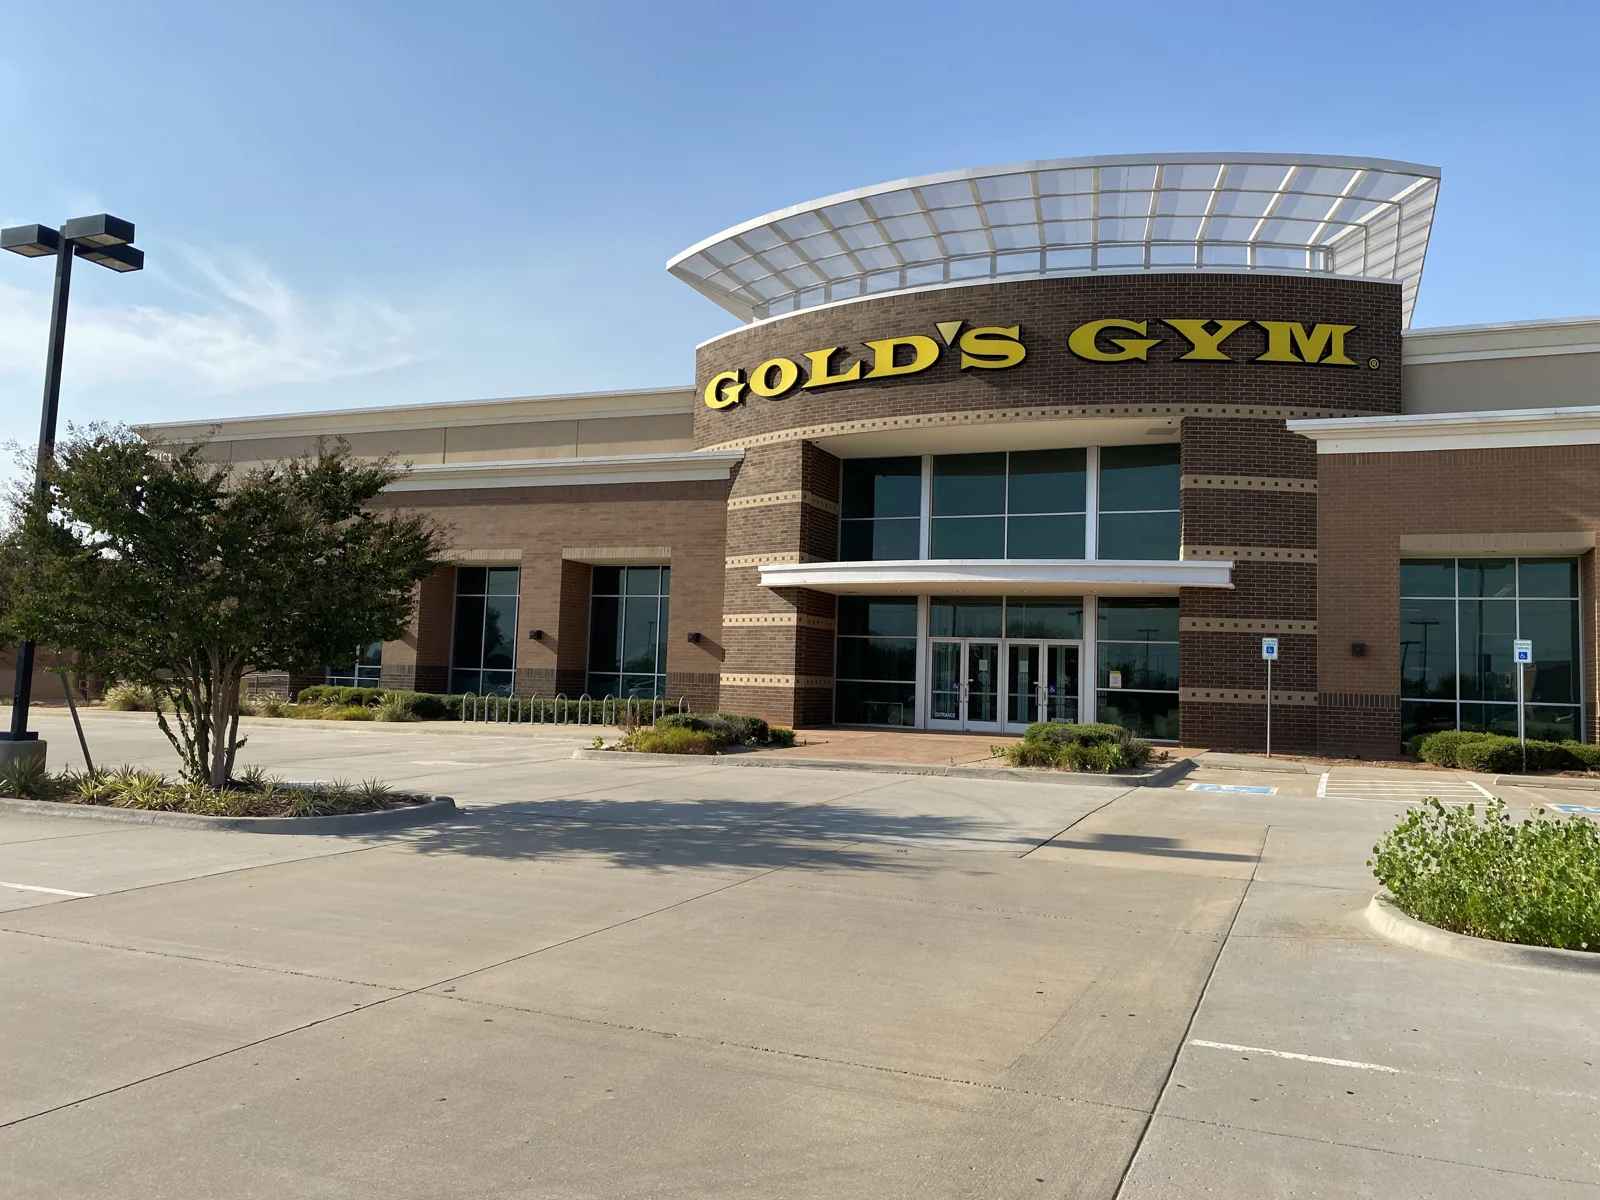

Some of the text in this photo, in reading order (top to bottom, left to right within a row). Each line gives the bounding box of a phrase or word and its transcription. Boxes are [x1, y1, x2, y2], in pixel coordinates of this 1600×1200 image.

[704, 320, 1026, 409] GOLD'S
[1067, 318, 1358, 366] GYM
[934, 711, 956, 719] ENTRANCE
